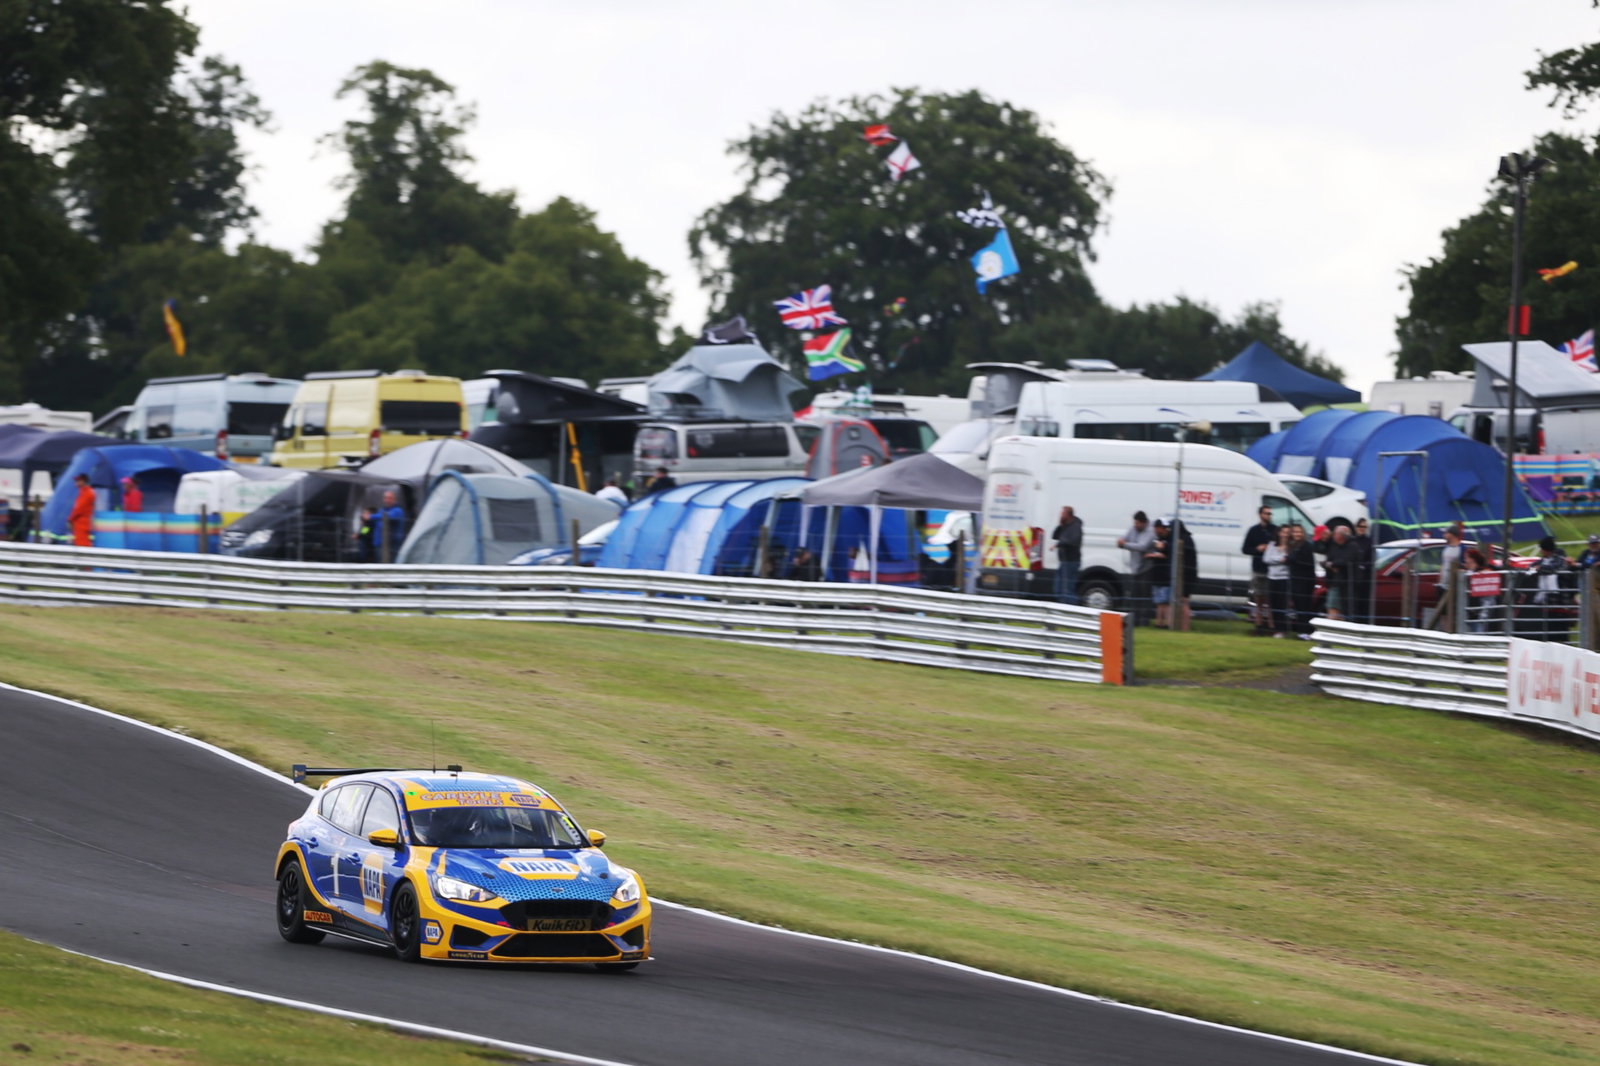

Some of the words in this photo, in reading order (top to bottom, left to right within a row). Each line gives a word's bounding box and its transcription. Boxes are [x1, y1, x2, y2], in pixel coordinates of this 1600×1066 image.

[421, 791, 502, 801] CARLYLE
[510, 860, 570, 872] NAPA
[363, 868, 382, 901] NAPA
[304, 911, 332, 922] AUTOCAR
[427, 926, 439, 937] NAPA
